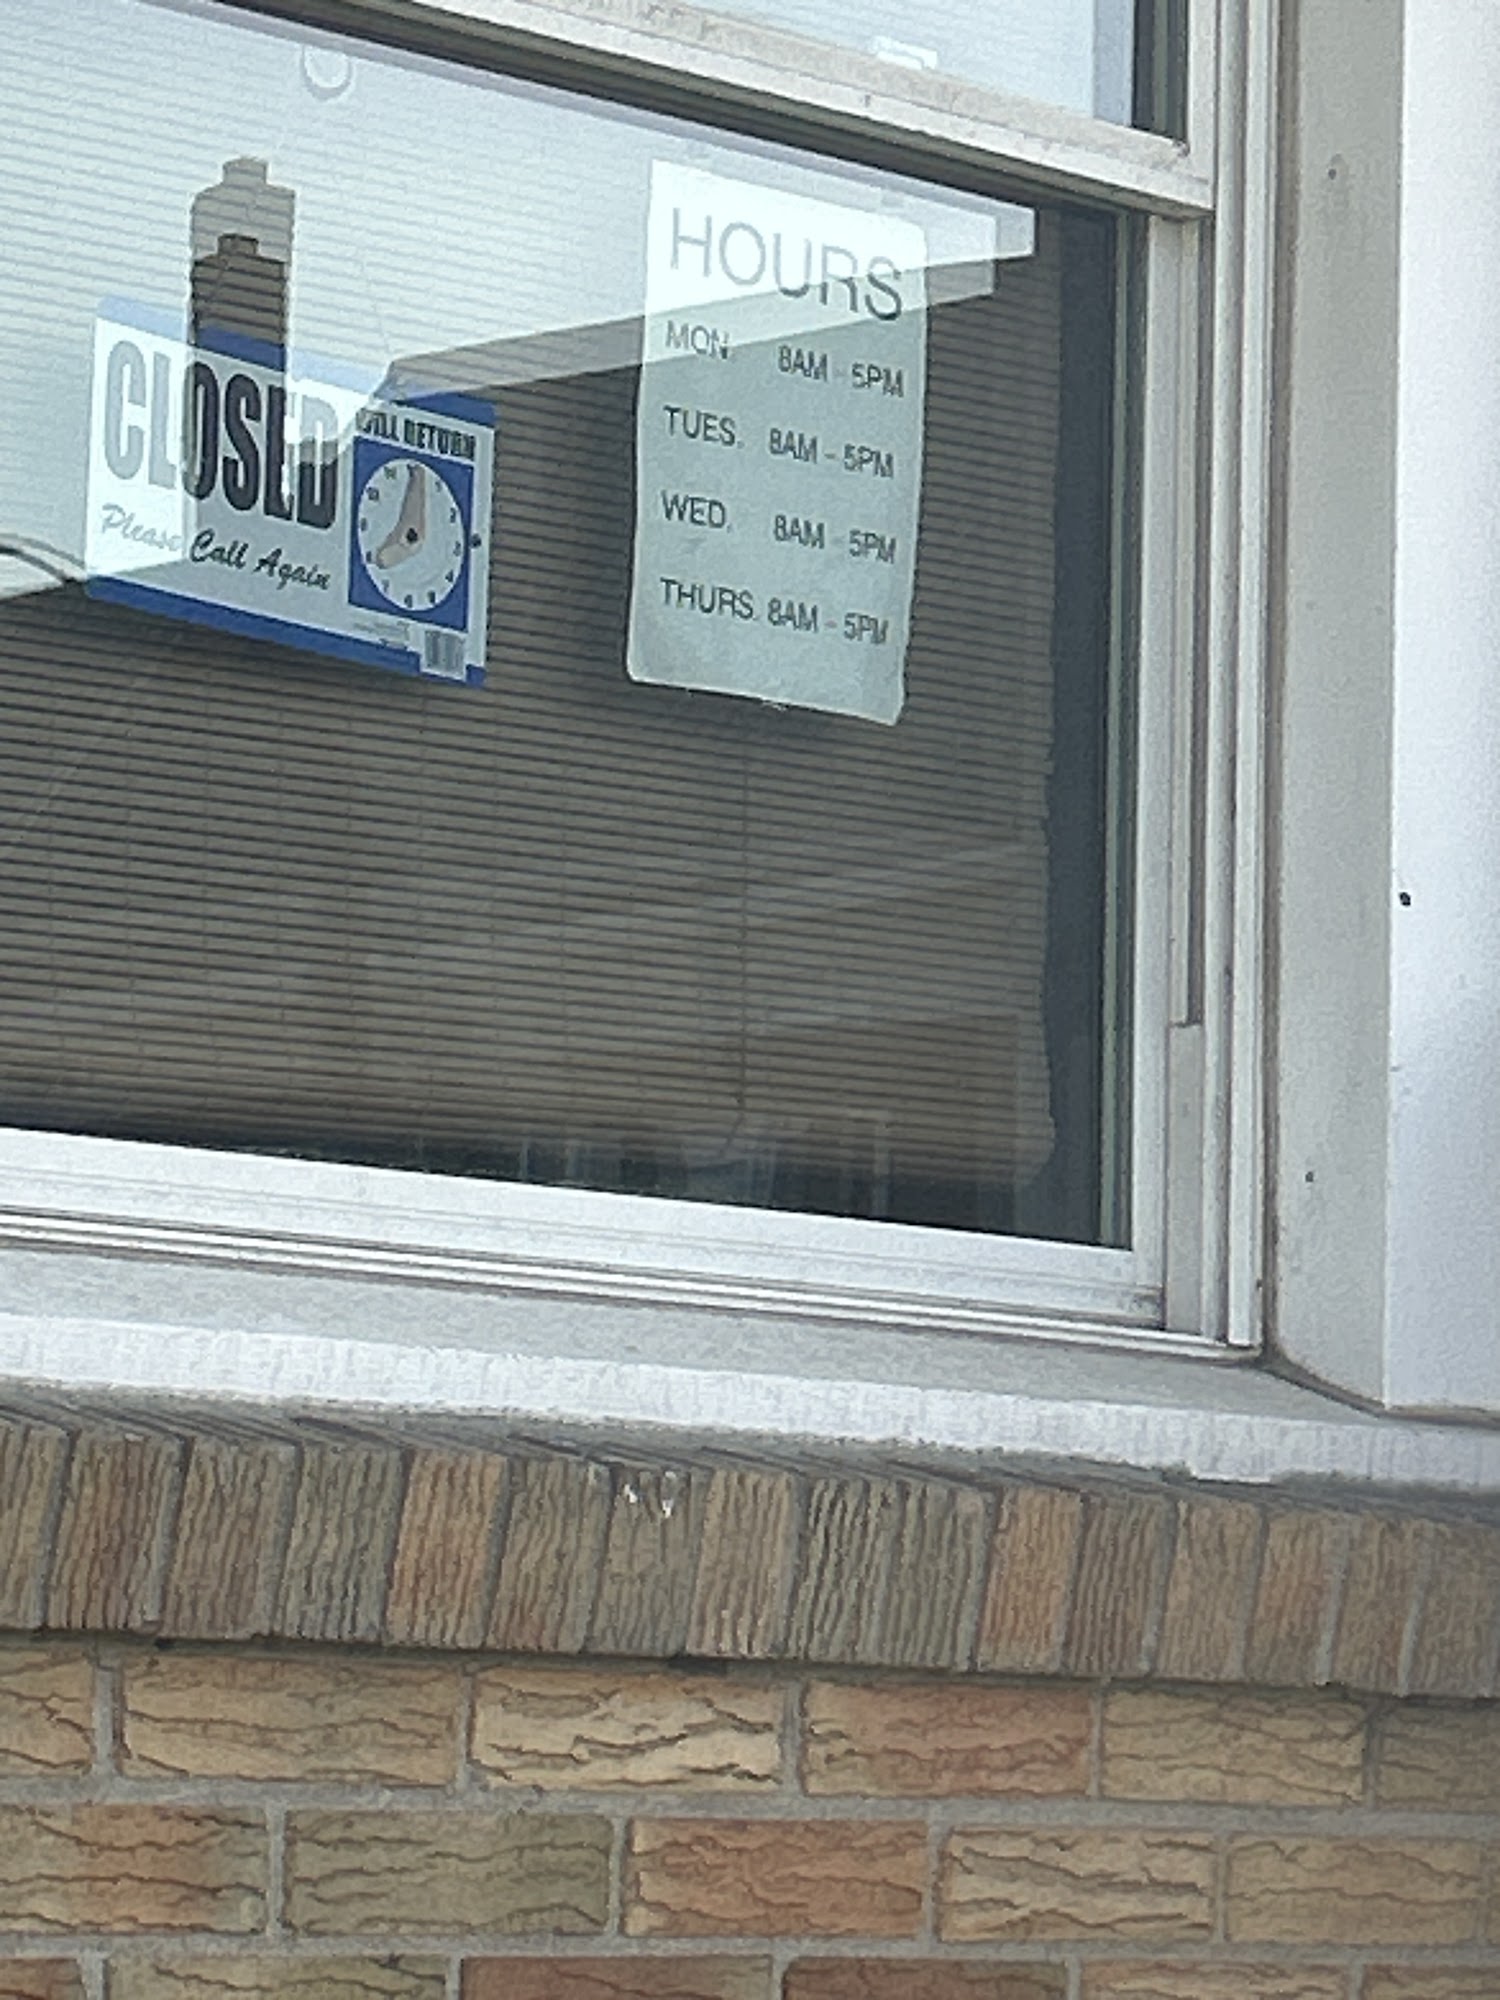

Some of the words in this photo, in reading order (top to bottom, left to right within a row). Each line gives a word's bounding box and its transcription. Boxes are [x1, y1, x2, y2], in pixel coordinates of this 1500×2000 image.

[670, 207, 902, 321] HOURS
[778, 345, 828, 382] 8AM
[852, 362, 904, 398] 5PM
[104, 340, 338, 530] CLOSED
[663, 405, 745, 448] TUES.
[769, 428, 817, 464] 8AM
[844, 444, 893, 478] 5PM
[102, 503, 184, 551] Please
[189, 528, 249, 570] Call
[253, 548, 331, 590] Again
[661, 490, 733, 533] WED.
[774, 514, 825, 549] 8AM
[849, 530, 896, 564] 5PM
[660, 577, 759, 621] THURS.
[767, 598, 818, 633] 8AM
[844, 612, 890, 644] 5PM
